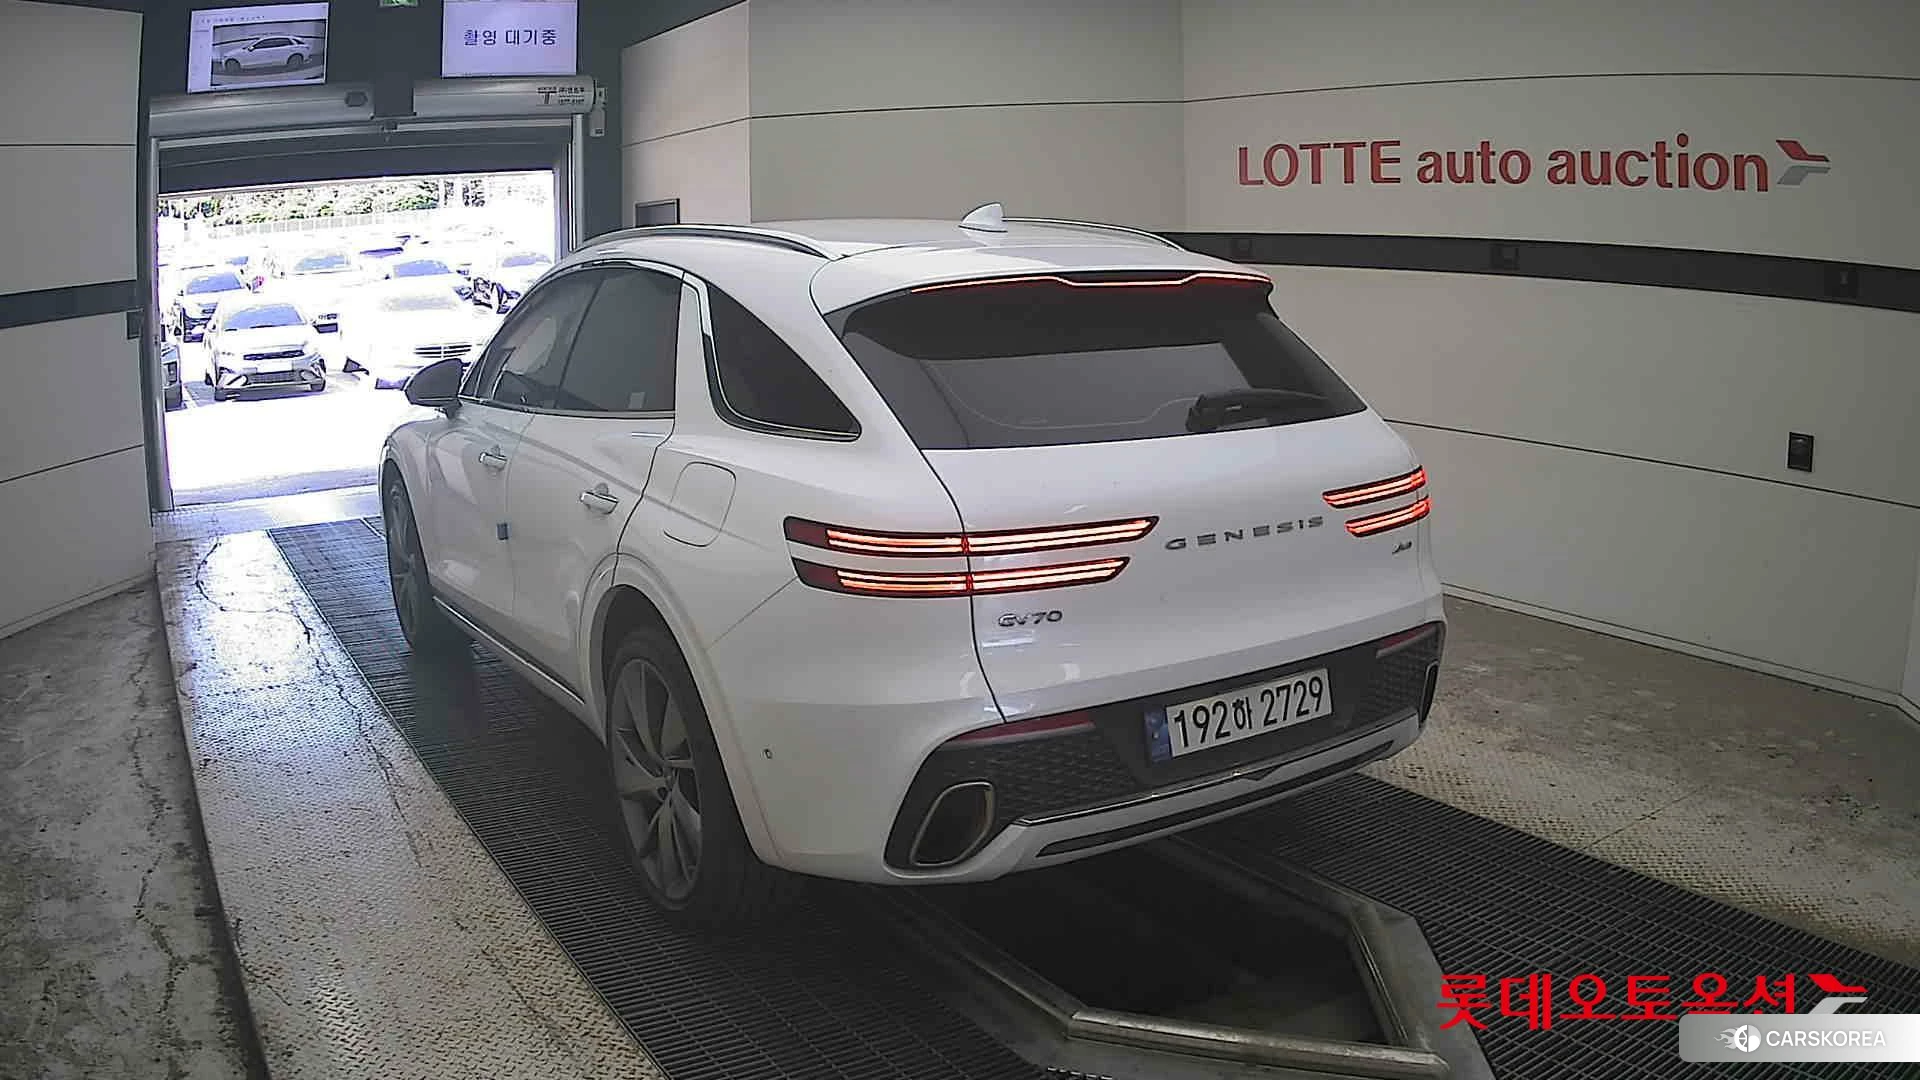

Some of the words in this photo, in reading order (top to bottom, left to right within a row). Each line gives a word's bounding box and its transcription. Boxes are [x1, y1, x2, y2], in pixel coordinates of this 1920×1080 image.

[505, 29, 557, 46] 대기중
[1238, 139, 1401, 187] LOTTE
[1416, 140, 1532, 185] auto
[1547, 132, 1769, 193] auction
[1165, 515, 1324, 551] GENESIS
[1173, 695, 1253, 748] 192하
[1259, 675, 1324, 728] 2729
